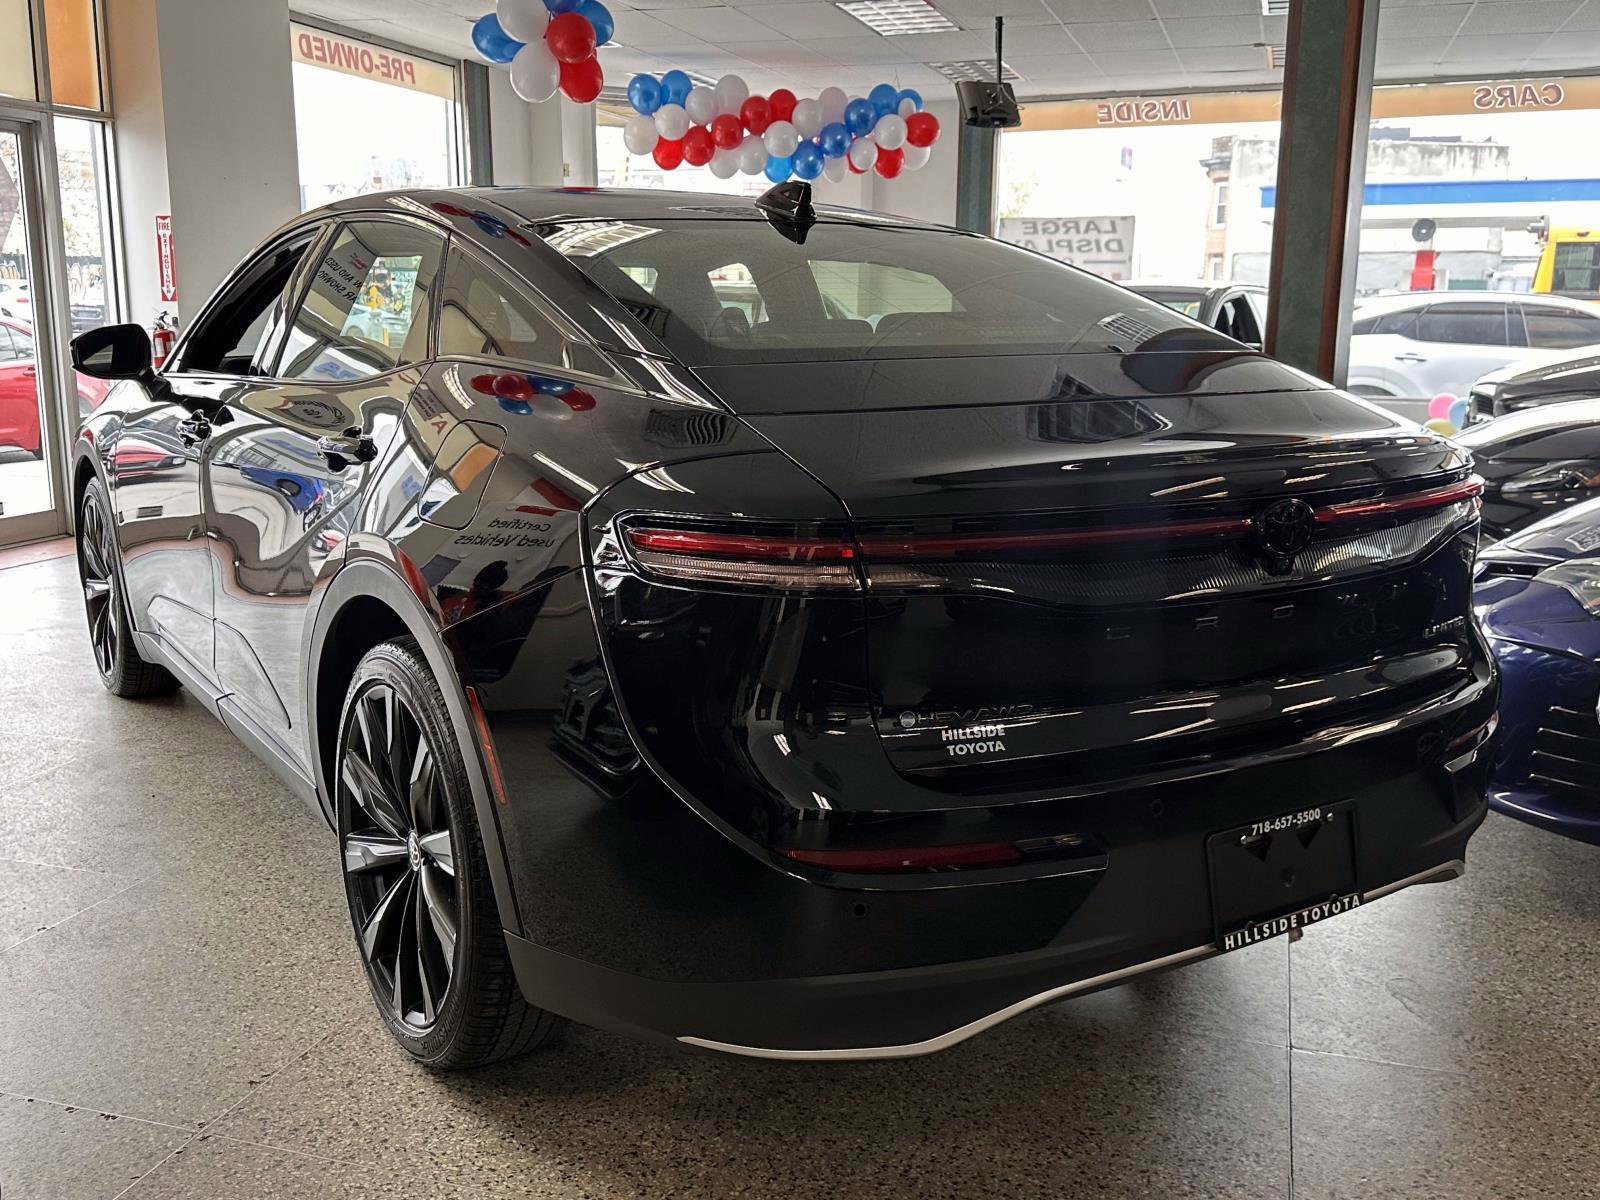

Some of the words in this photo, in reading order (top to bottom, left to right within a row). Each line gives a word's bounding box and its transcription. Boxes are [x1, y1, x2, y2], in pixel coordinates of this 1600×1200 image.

[158, 222, 170, 231] FIRE
[941, 725, 1006, 742] HILLSIDE
[946, 741, 1006, 756] TOYOTA
[1251, 808, 1321, 836] 718-657-5500
[1224, 914, 1299, 950] HILLSIDE
[1301, 895, 1361, 924] TOYOTA
